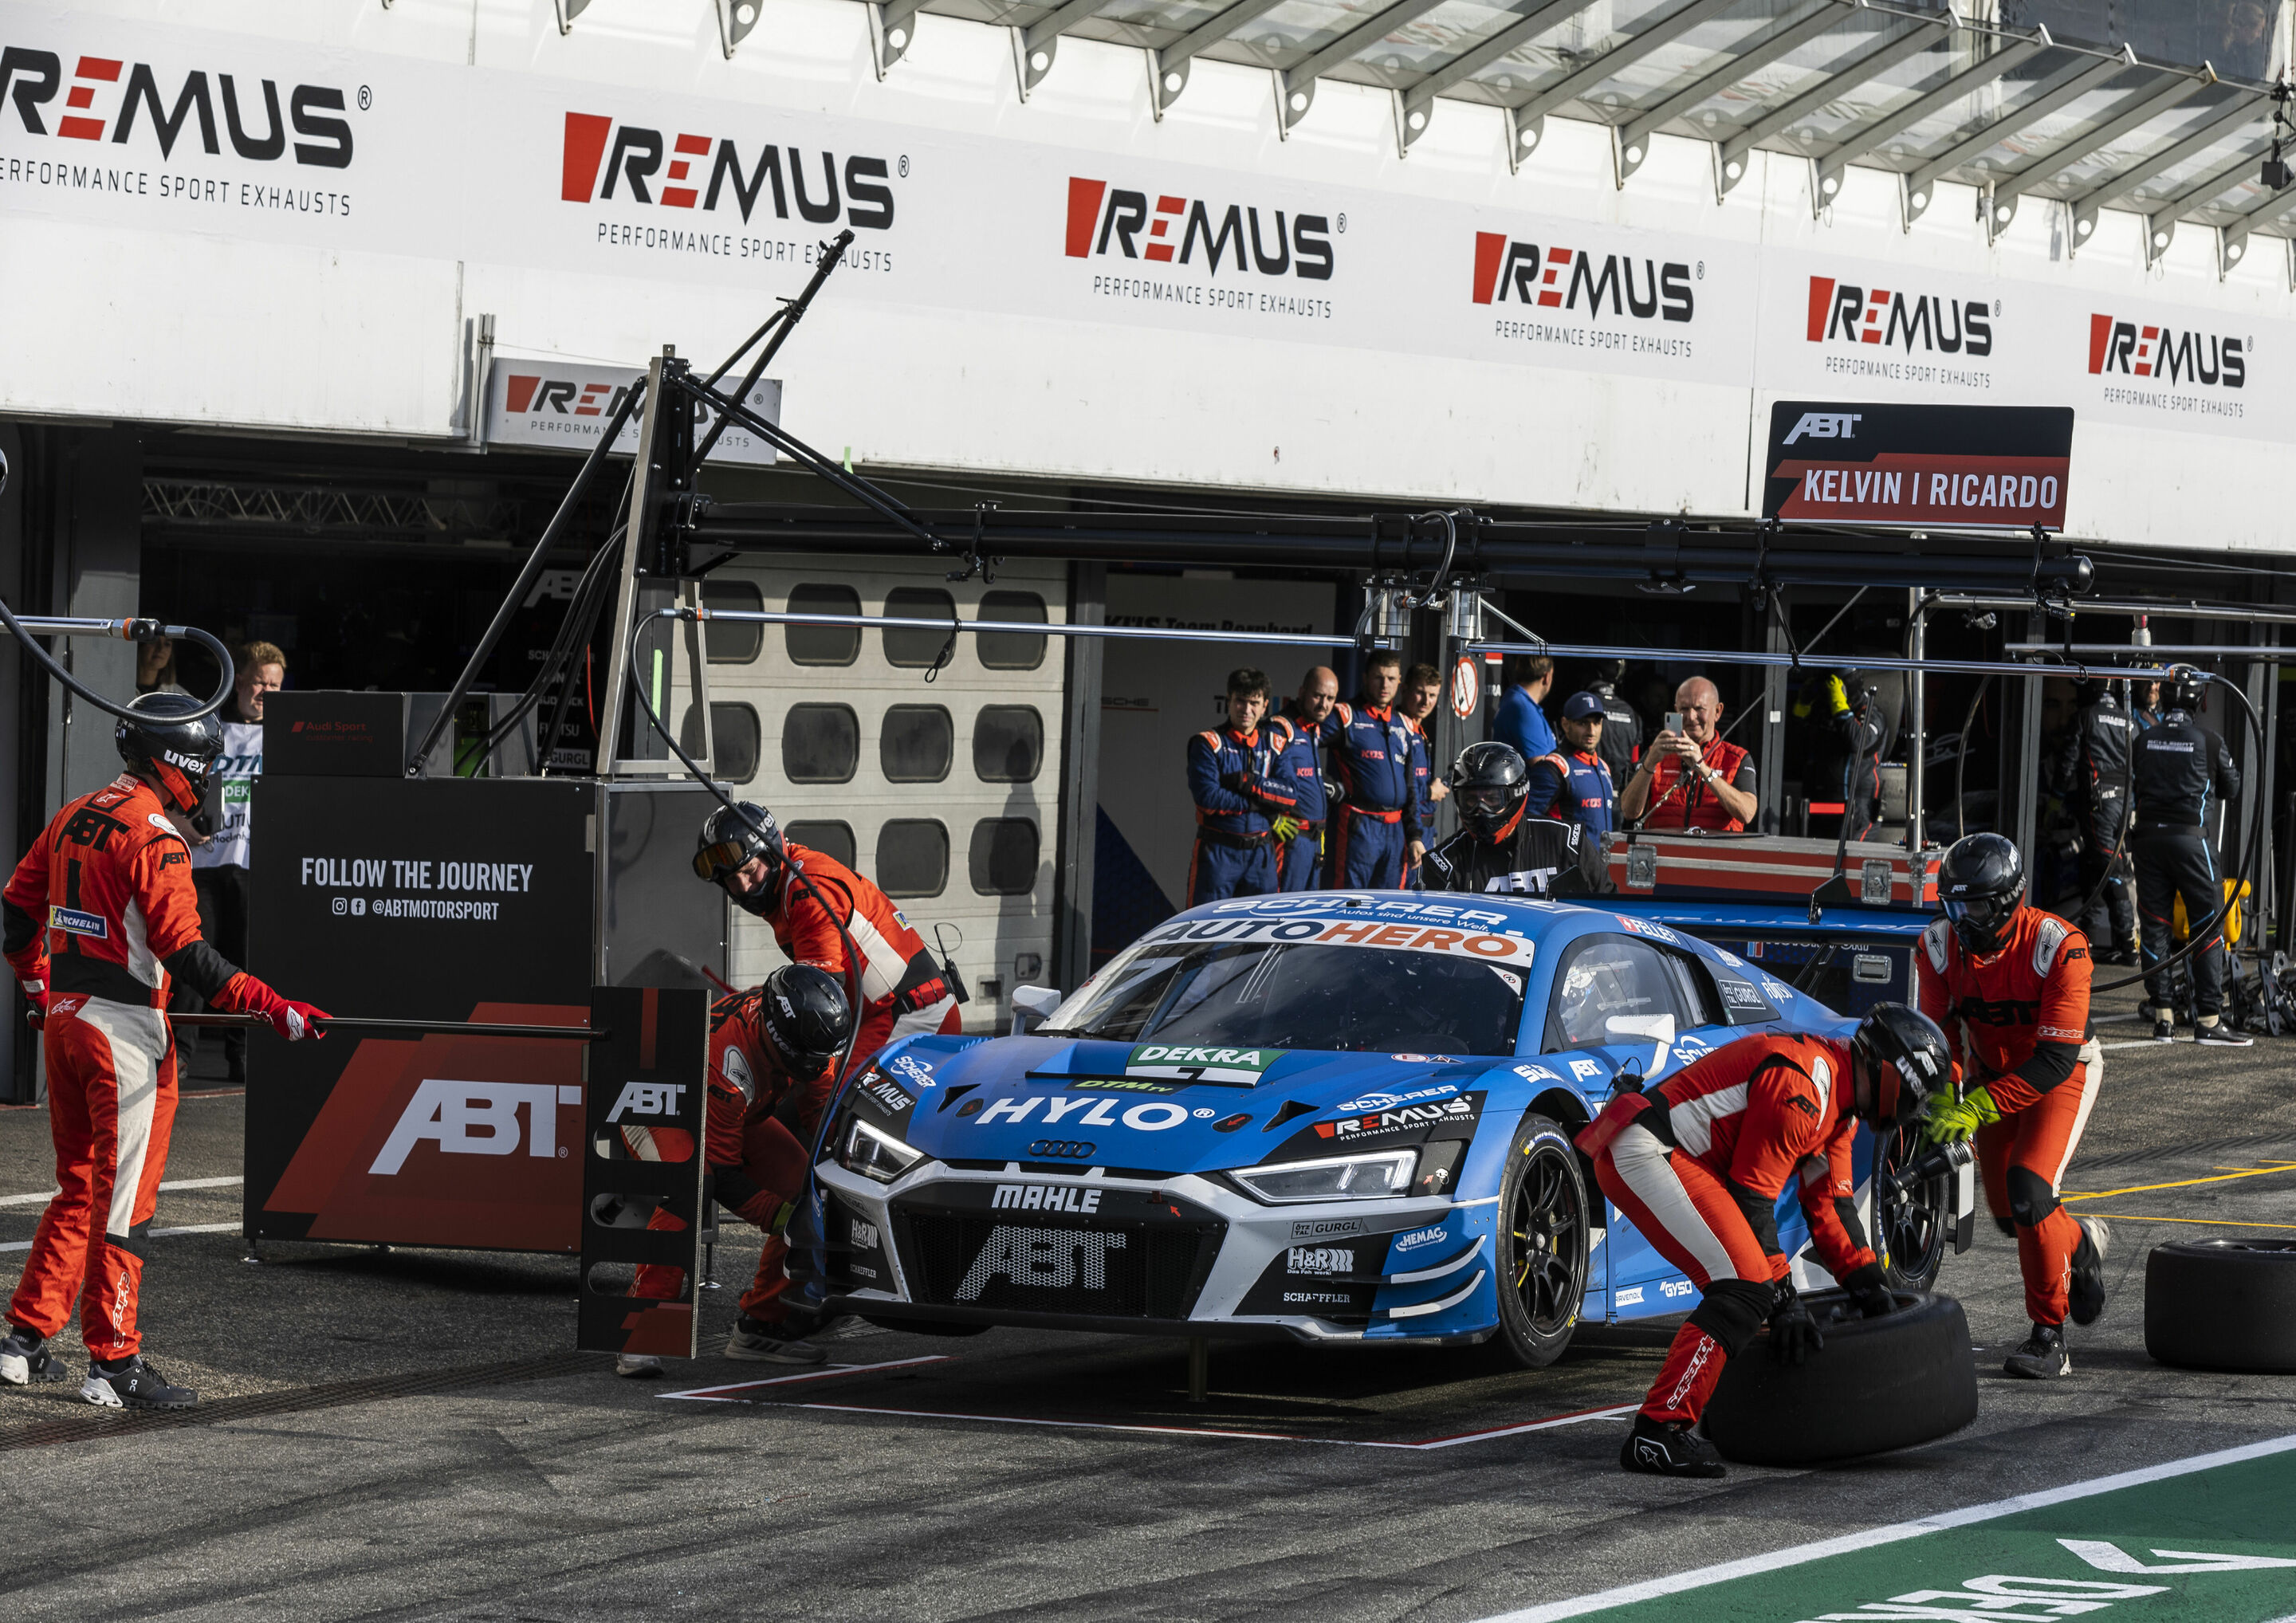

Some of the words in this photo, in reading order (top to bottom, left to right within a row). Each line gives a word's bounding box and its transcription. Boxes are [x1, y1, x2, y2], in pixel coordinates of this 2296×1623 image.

[0, 157, 148, 195] ERFORMANCE
[159, 175, 230, 203] SPORT
[241, 183, 351, 217] EXHAUSTS
[598, 222, 732, 256] PERFORMANCE
[740, 237, 796, 263] SPORT
[804, 244, 892, 273] EXAUSTS
[1094, 275, 1201, 305] PERFORMANCE
[1209, 288, 1254, 312] SPORT
[1260, 294, 1331, 319] EXHAUSTS
[1496, 320, 1584, 345] PERFORMANCE
[1590, 329, 1626, 351] SPORT
[1632, 334, 1693, 358] EXHAUSTS
[1826, 356, 1901, 379] PERFORMANCE
[1905, 365, 1936, 383] SPORT
[1940, 370, 1991, 388] EXHAUSTS
[2104, 387, 2167, 410] PERFORMANCE
[2171, 395, 2198, 413] SPORT
[2201, 399, 2244, 419] EXHAUSTS
[1804, 470, 1901, 505] KELVIN
[1929, 474, 2058, 509] RICARDO
[306, 721, 332, 733] Audi
[334, 721, 368, 734] Sport
[163, 749, 206, 774] uvex
[159, 852, 186, 870] ABT
[301, 858, 387, 888] FOLLOW
[392, 861, 431, 889] THE
[437, 863, 533, 892] JOURNEY
[372, 899, 499, 921] @ABTMOTORSPORT
[1212, 895, 1508, 925] SCHERER
[1336, 908, 1373, 918] Autos
[1408, 915, 1451, 925] unsere
[1457, 922, 1491, 932] Welt.
[1146, 920, 1518, 957] AUTOHERO
[1631, 919, 1681, 945] FELLER
[2062, 948, 2086, 965] ABT
[776, 996, 796, 1019] ABT
[1138, 1047, 1260, 1066] DEKRA
[1569, 1059, 1602, 1083] ABT
[1075, 1080, 1149, 1090] DTM
[1337, 1085, 1458, 1111] SCHERER
[1786, 1093, 1821, 1119] ABT
[1340, 1126, 1400, 1141] PERFORMANCE
[1403, 1121, 1429, 1130] SPORT
[992, 1185, 1103, 1213] MAHLE
[1315, 1221, 1358, 1233] GURGL
[1403, 1227, 1443, 1245] HEMAG
[954, 1226, 1126, 1299] ABT
